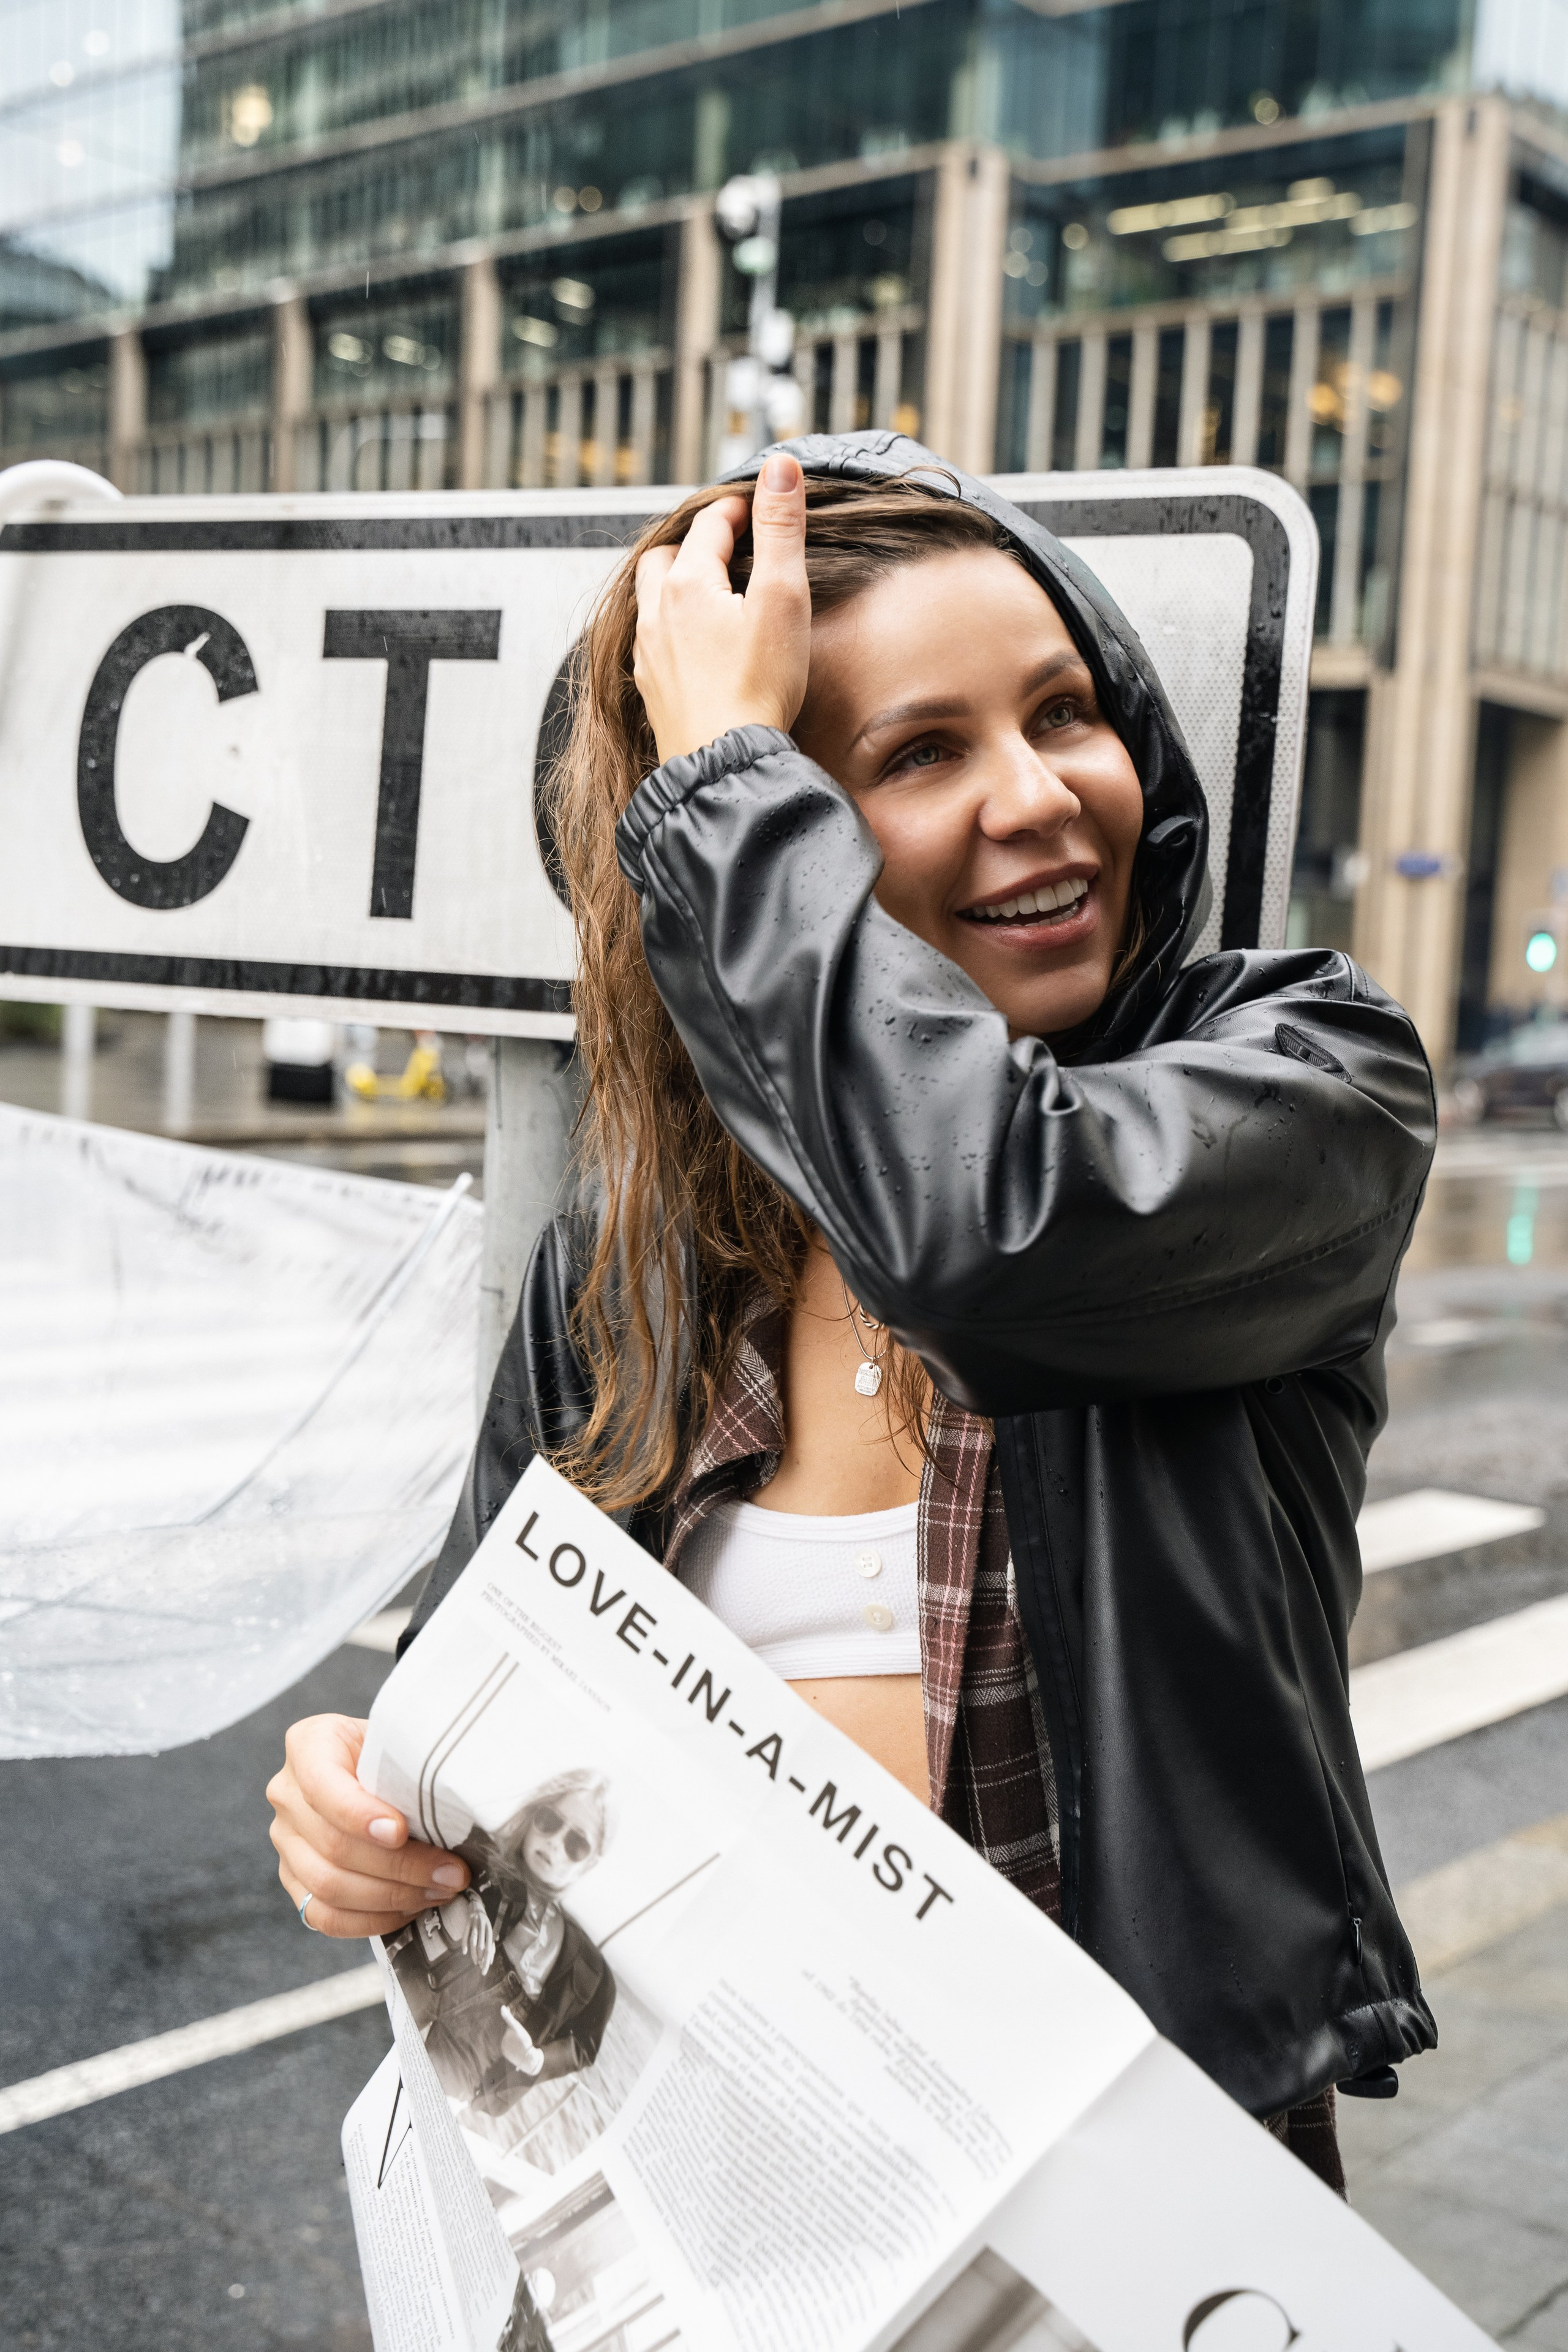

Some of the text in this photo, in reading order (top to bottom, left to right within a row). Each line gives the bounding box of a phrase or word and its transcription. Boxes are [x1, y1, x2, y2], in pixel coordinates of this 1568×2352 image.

[486, 1581, 562, 1651] ONE OF THE BIGGEST
[513, 1510, 954, 1922] LOVE-IN-A-MIST
